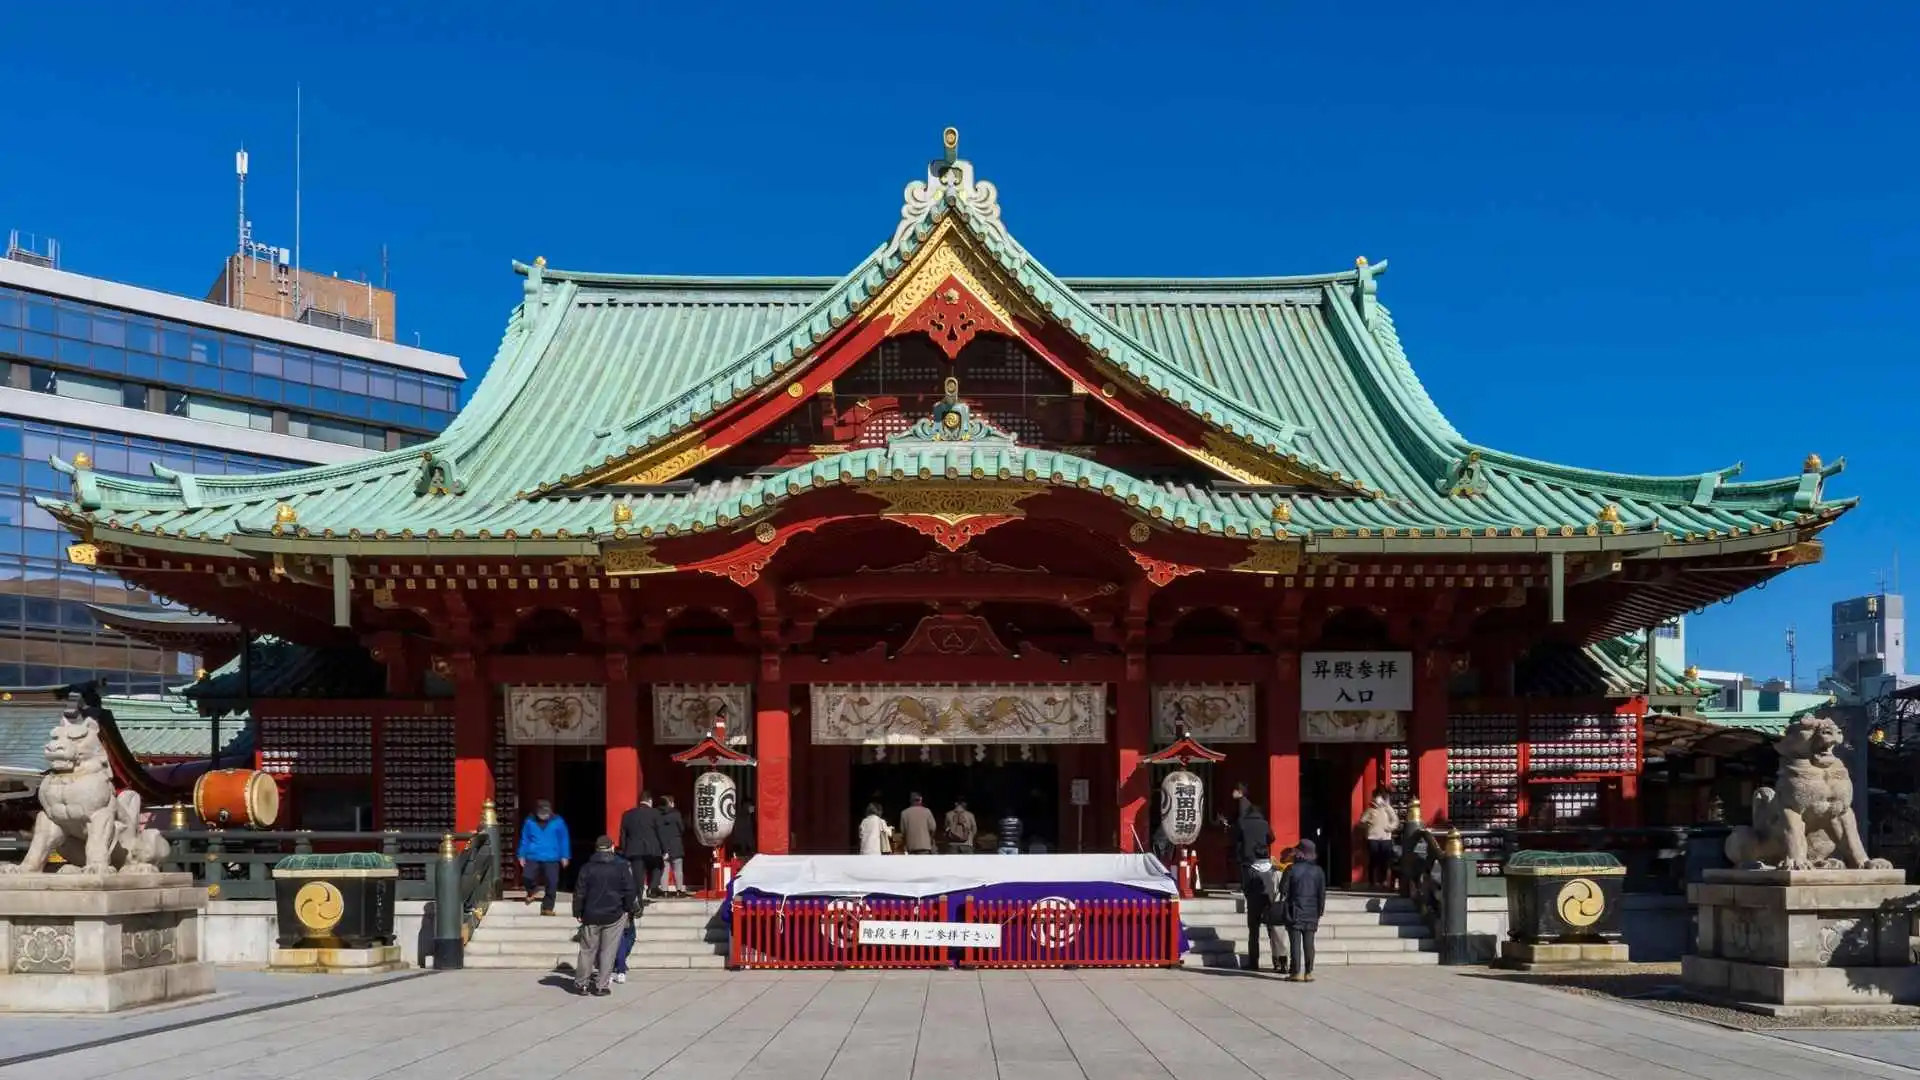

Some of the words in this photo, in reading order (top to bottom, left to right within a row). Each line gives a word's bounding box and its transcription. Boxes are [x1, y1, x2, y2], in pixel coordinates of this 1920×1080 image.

[1312, 659, 1397, 679] 昇殿参拝
[1335, 687, 1374, 704] 入口
[697, 783, 719, 835] 神田明神
[1176, 783, 1196, 834] 神田明神
